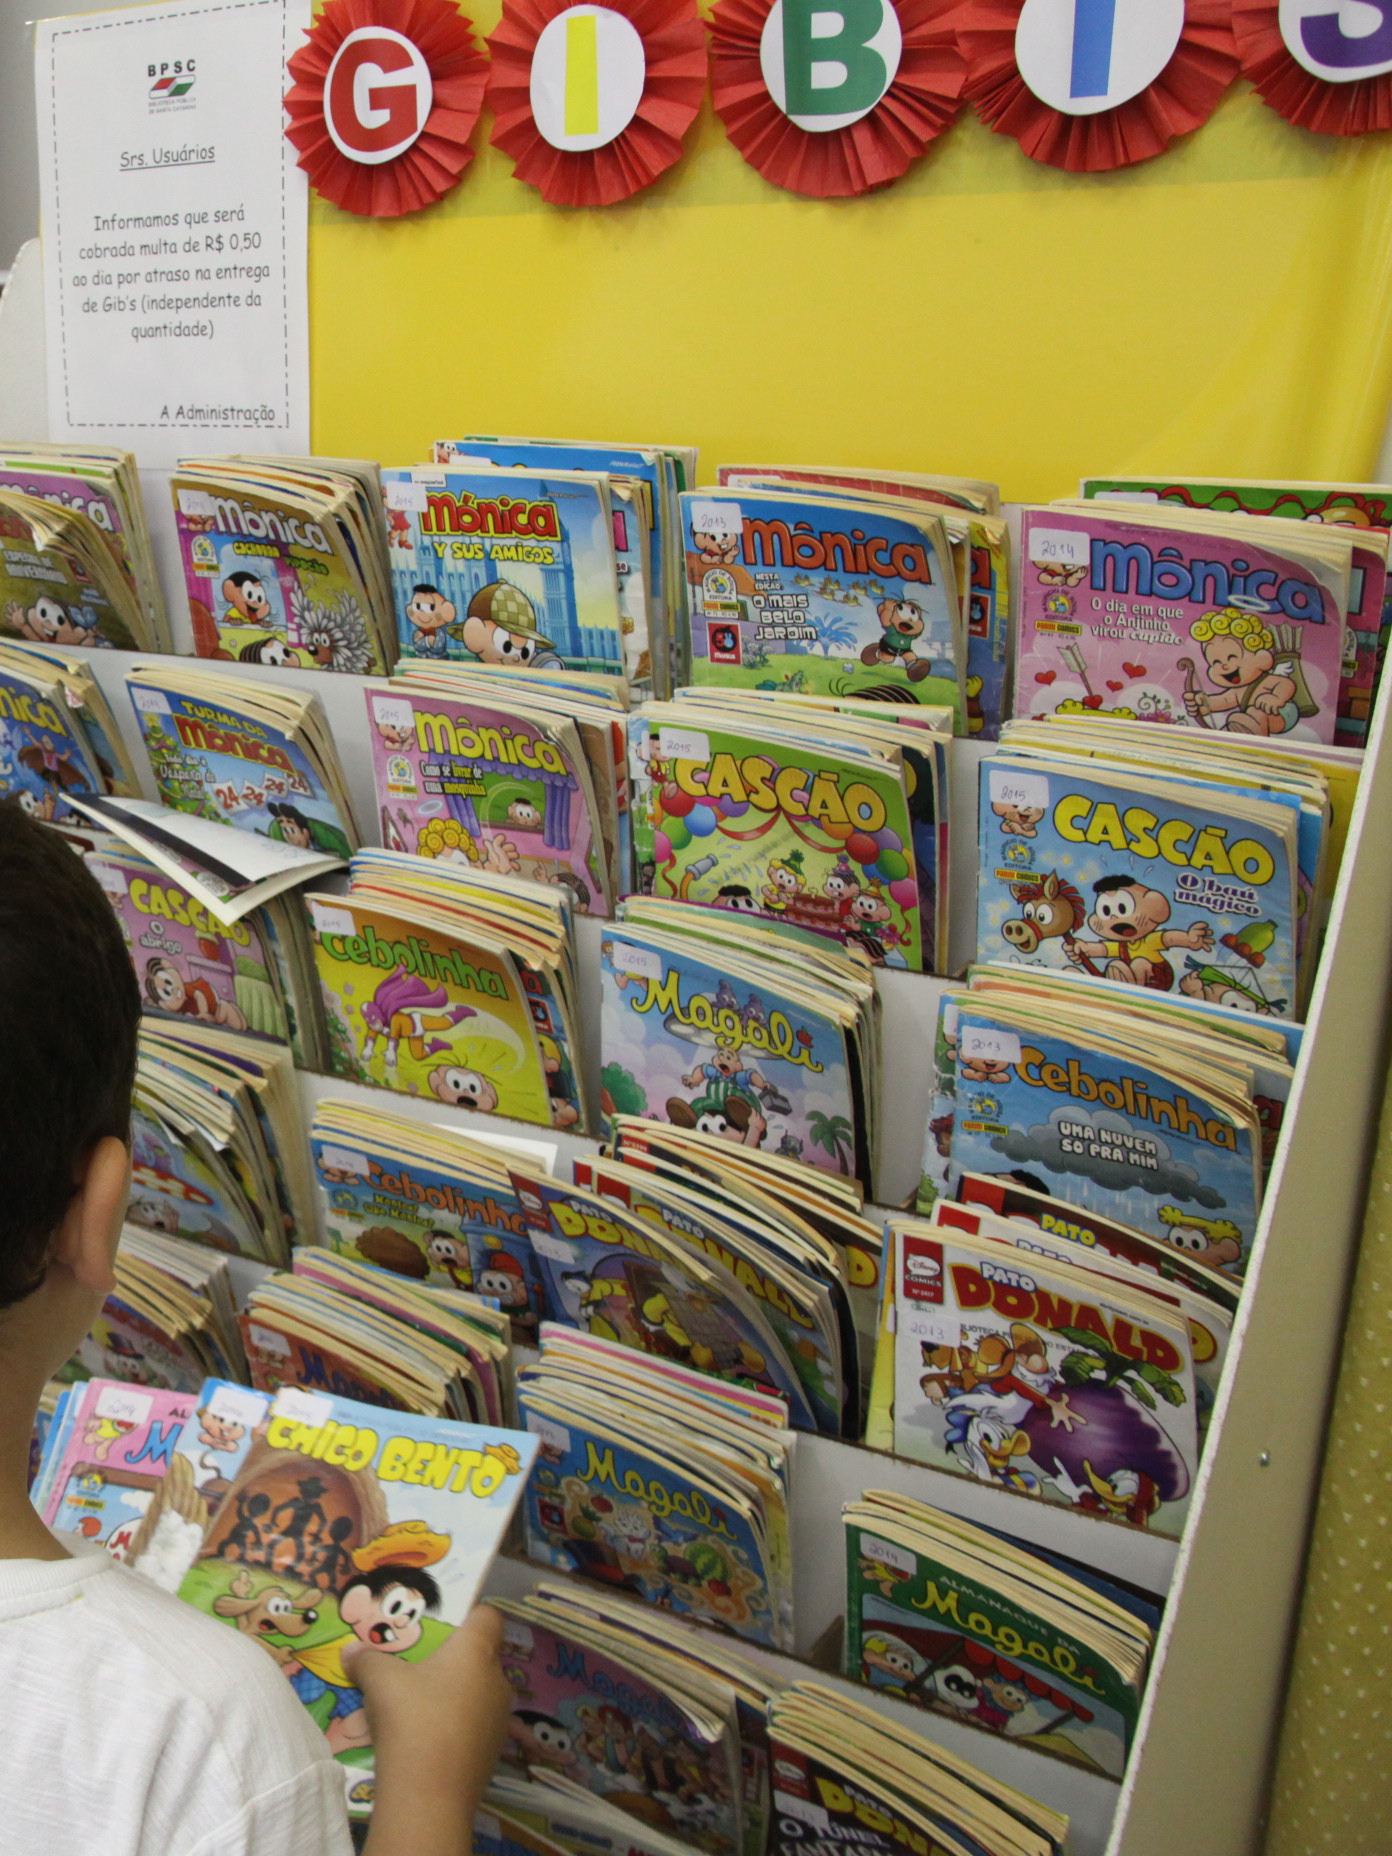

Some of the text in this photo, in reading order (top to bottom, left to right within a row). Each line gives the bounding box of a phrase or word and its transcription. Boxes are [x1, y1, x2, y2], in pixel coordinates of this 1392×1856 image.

[148, 58, 196, 77] BPSC
[120, 145, 215, 168] Srs. Usuários
[94, 203, 245, 231] Informamos que será
[79, 232, 261, 259] cobrada multa de R$ 0,50
[72, 264, 270, 289] ao dia por atraso na entrega
[82, 290, 262, 314] de Gib's (independente da
[131, 319, 214, 343] quantidade)
[160, 404, 275, 426] A Administração
[433, 542, 555, 566] Y SUS AMIGOS
[1042, 539, 1075, 558] 2014
[755, 573, 779, 581] NESTA
[752, 594, 766, 609] O
[1091, 597, 1184, 620] O dia em que
[1091, 624, 1127, 640] virou
[1129, 630, 1183, 646] cupido
[1103, 614, 1170, 633] o Anjinho
[180, 701, 270, 740] TURMA DA
[666, 739, 692, 754] 2015
[264, 777, 286, 795] 24
[288, 773, 309, 793] 24
[674, 752, 887, 833] CASCÃO
[1001, 785, 1027, 802] 2015
[215, 786, 241, 810] 24
[242, 786, 265, 807] 24
[1052, 793, 1276, 887] CASCÃO
[1004, 862, 1032, 871] EDITORA
[1176, 872, 1259, 904] O baú
[1173, 885, 1262, 917] mágico
[149, 920, 164, 936] O
[140, 935, 184, 956] abrigo
[630, 968, 825, 1074] Magali
[1014, 1046, 1238, 1152] Cebolinha
[1058, 1121, 1095, 1141] UMA
[1100, 1128, 1159, 1156] NUVEM
[1088, 1142, 1125, 1163] PRA
[1127, 1151, 1159, 1171] MIM
[661, 1207, 705, 1241] PATO
[1040, 1213, 1097, 1248] PATO
[904, 1274, 943, 1288] COMICS
[979, 1261, 1038, 1294] PATO
[948, 1262, 1186, 1376] DONALD
[911, 1323, 945, 1341] 2013
[265, 1414, 379, 1472] CHICO
[377, 1436, 509, 1498] BENTO
[576, 1441, 738, 1541] Magali
[869, 1541, 897, 1564] 2014
[939, 1575, 1081, 1656] ALMANAQUE DA
[911, 1579, 1107, 1697] Magali
[778, 1817, 805, 1838] O
